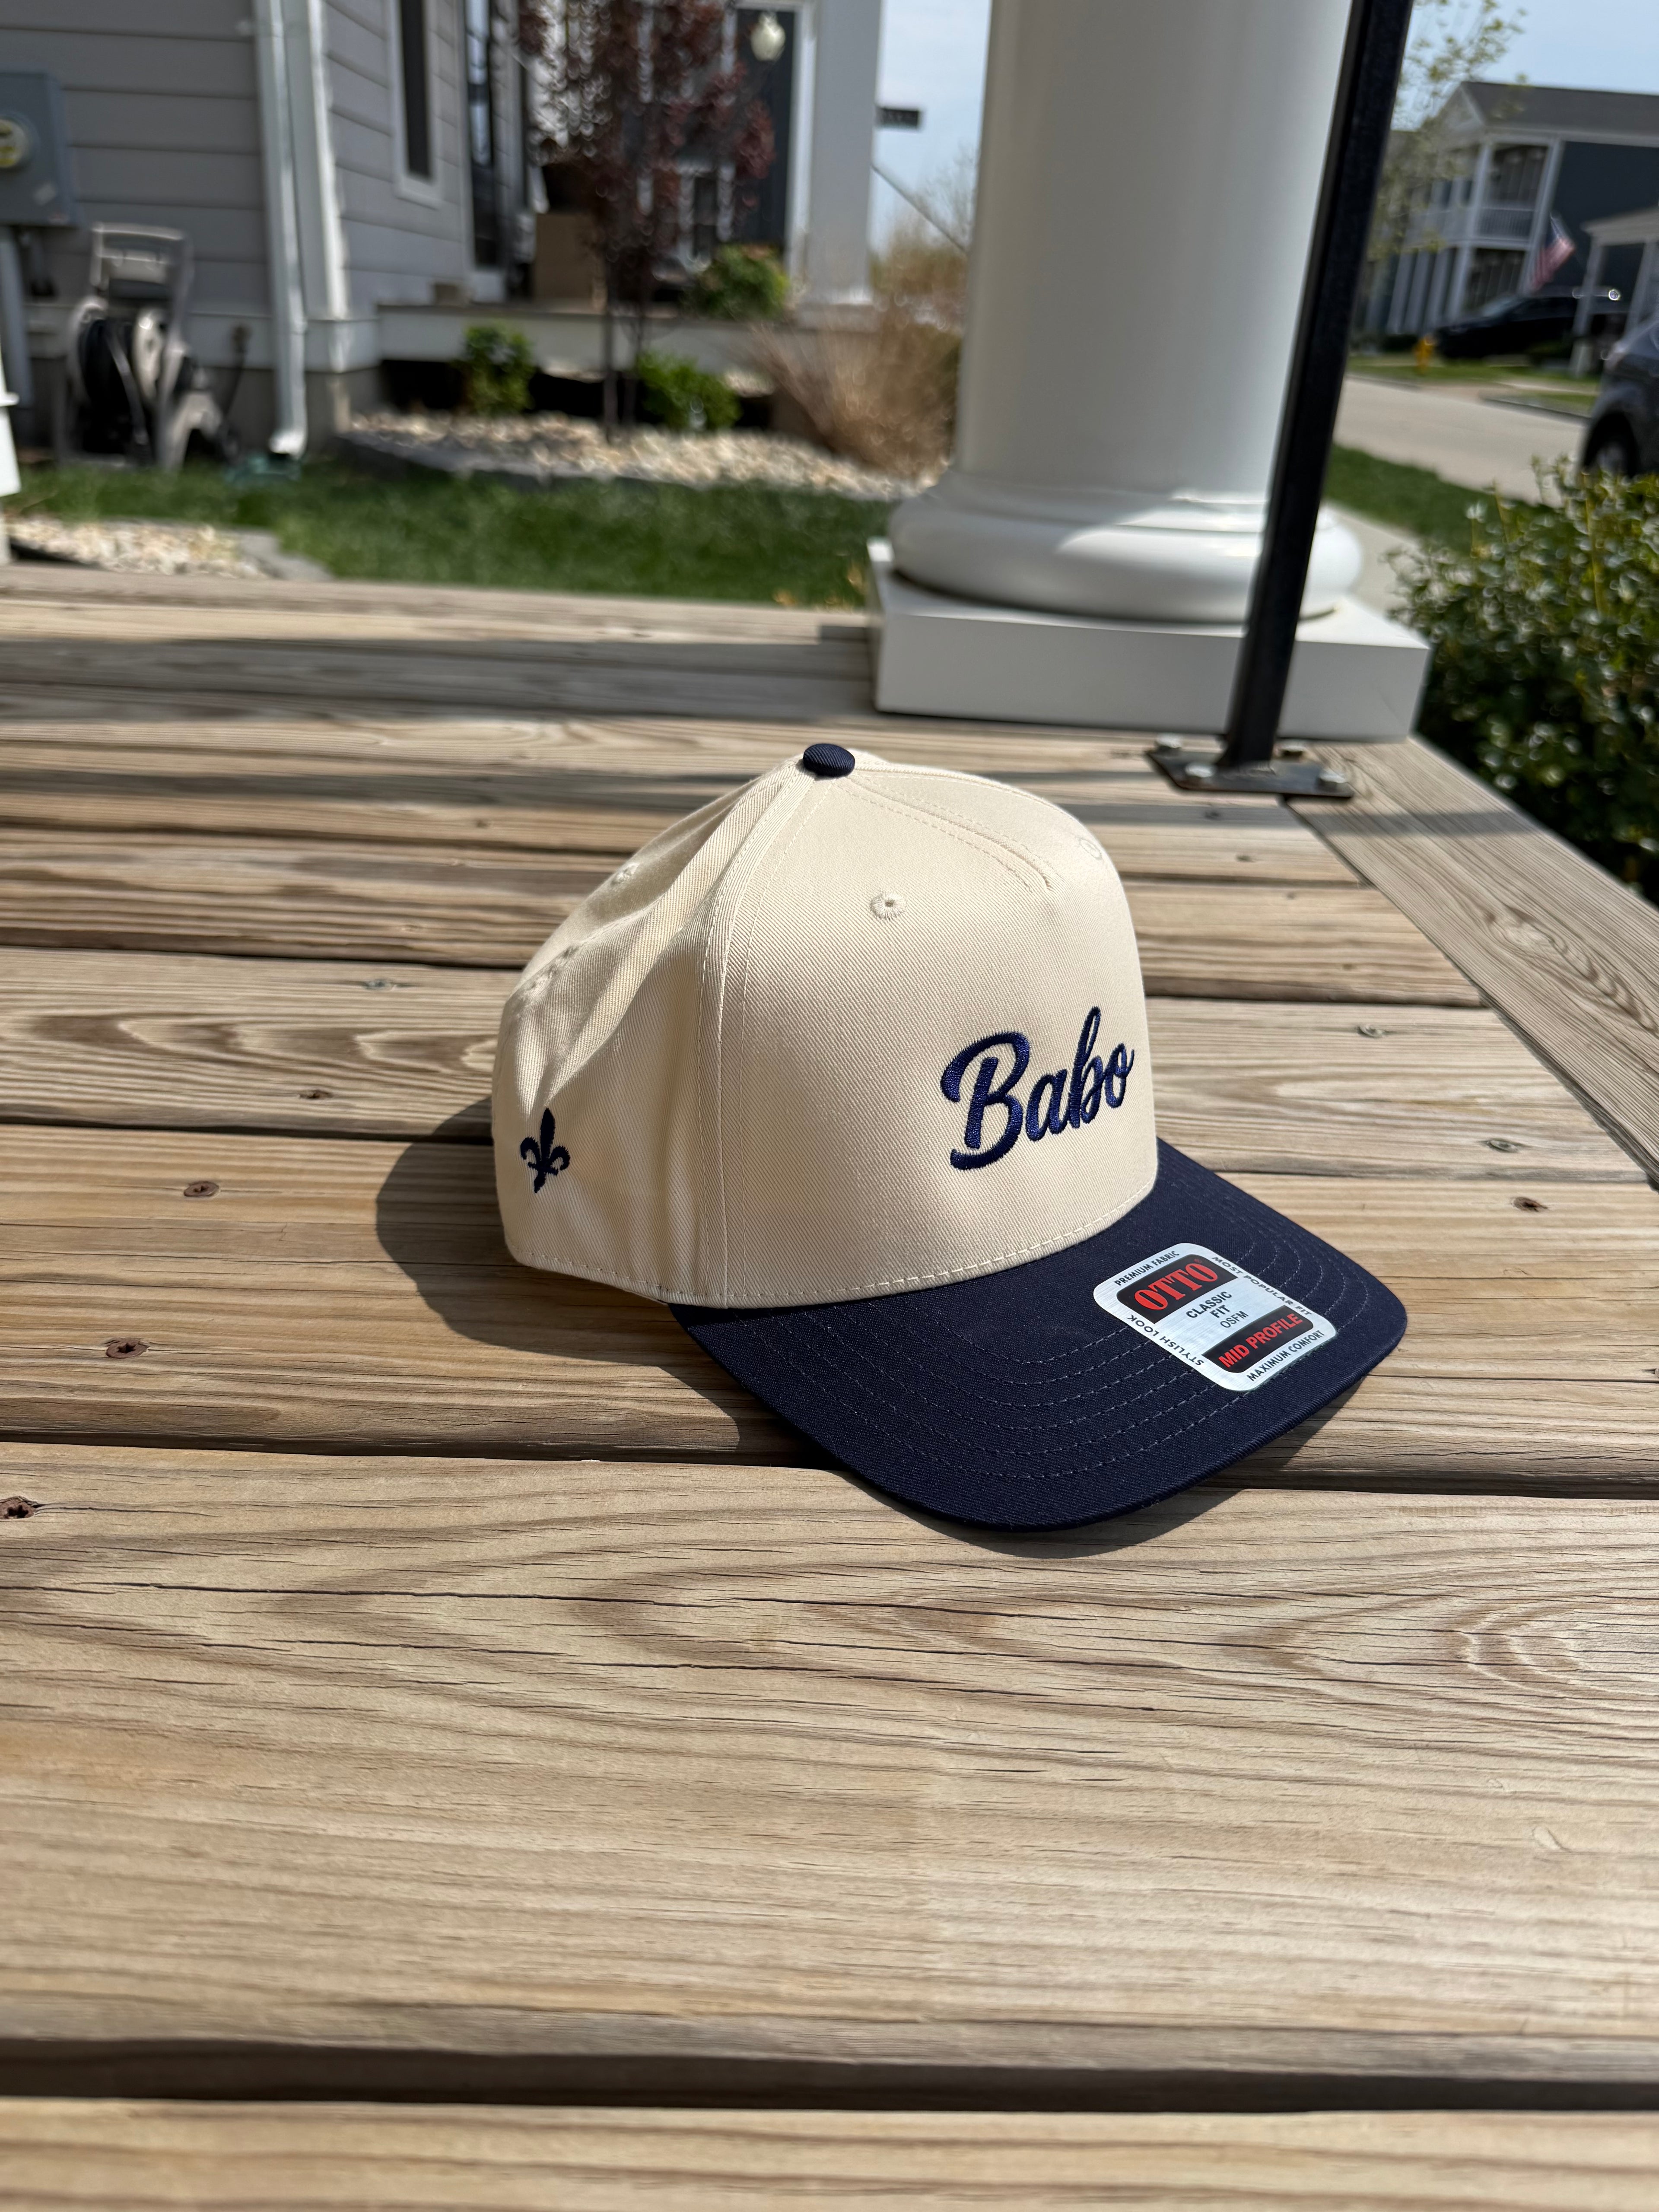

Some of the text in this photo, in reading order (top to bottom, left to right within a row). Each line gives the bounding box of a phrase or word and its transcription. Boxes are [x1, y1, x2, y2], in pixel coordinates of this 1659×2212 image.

[940, 1006, 1134, 1170] Babo
[1114, 1251, 1179, 1286] PREMIUM FABRIC
[1135, 1263, 1218, 1310] OTTO
[1212, 1257, 1312, 1316] MOST POPULAR FIT
[1186, 1291, 1232, 1318] CLASSIC
[1210, 1305, 1230, 1318] FIT
[1220, 1311, 1249, 1328] OSFM
[1127, 1314, 1204, 1365] STYLISH LOOK
[1218, 1313, 1303, 1368] MID PROFILE
[1246, 1330, 1325, 1381] MAXIMUM COMFORT
